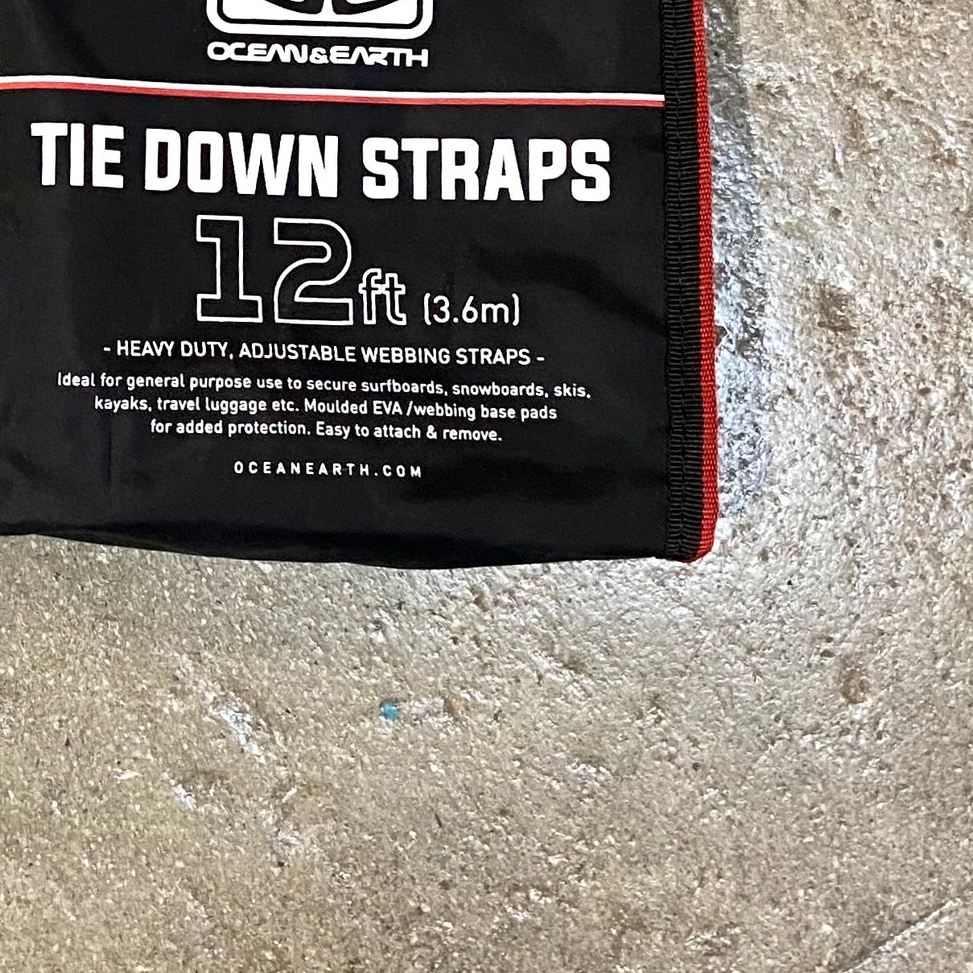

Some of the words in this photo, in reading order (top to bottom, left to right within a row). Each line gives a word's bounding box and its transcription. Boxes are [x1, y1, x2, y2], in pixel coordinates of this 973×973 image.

[30, 122, 125, 189] TIE
[144, 127, 339, 198] DOWN
[362, 137, 611, 202] STRAPS
[423, 292, 520, 327] (3.6m)
[116, 339, 175, 357] HEAVY
[180, 340, 234, 360] DUTY,
[238, 342, 357, 363] ADJUSTABLE
[360, 346, 451, 365] WEBBING
[455, 347, 531, 366] STRAPS
[57, 371, 96, 387] Ideal
[100, 372, 123, 388] for
[126, 373, 186, 392] general
[189, 376, 252, 392] purpose
[256, 378, 283, 390] use
[287, 377, 302, 390] to
[306, 379, 357, 392] secure
[360, 378, 448, 397] surfboards,
[451, 381, 550, 399] snowboards,
[94, 395, 154, 413] kayaks,
[156, 396, 201, 411] travel
[205, 396, 267, 415] luggage
[271, 398, 300, 412] etc.
[304, 397, 368, 415] Moulded
[372, 400, 403, 416] EVA
[480, 403, 516, 419] base
[520, 404, 558, 423] pads
[151, 418, 173, 434] for
[175, 418, 223, 435] added
[227, 420, 311, 438] protection.
[315, 420, 351, 440] Easy
[355, 423, 370, 438] to
[373, 424, 421, 439] attach
[425, 424, 438, 440] &
[442, 428, 503, 442] remove.
[233, 460, 422, 478] OCEANEARTH.COM
